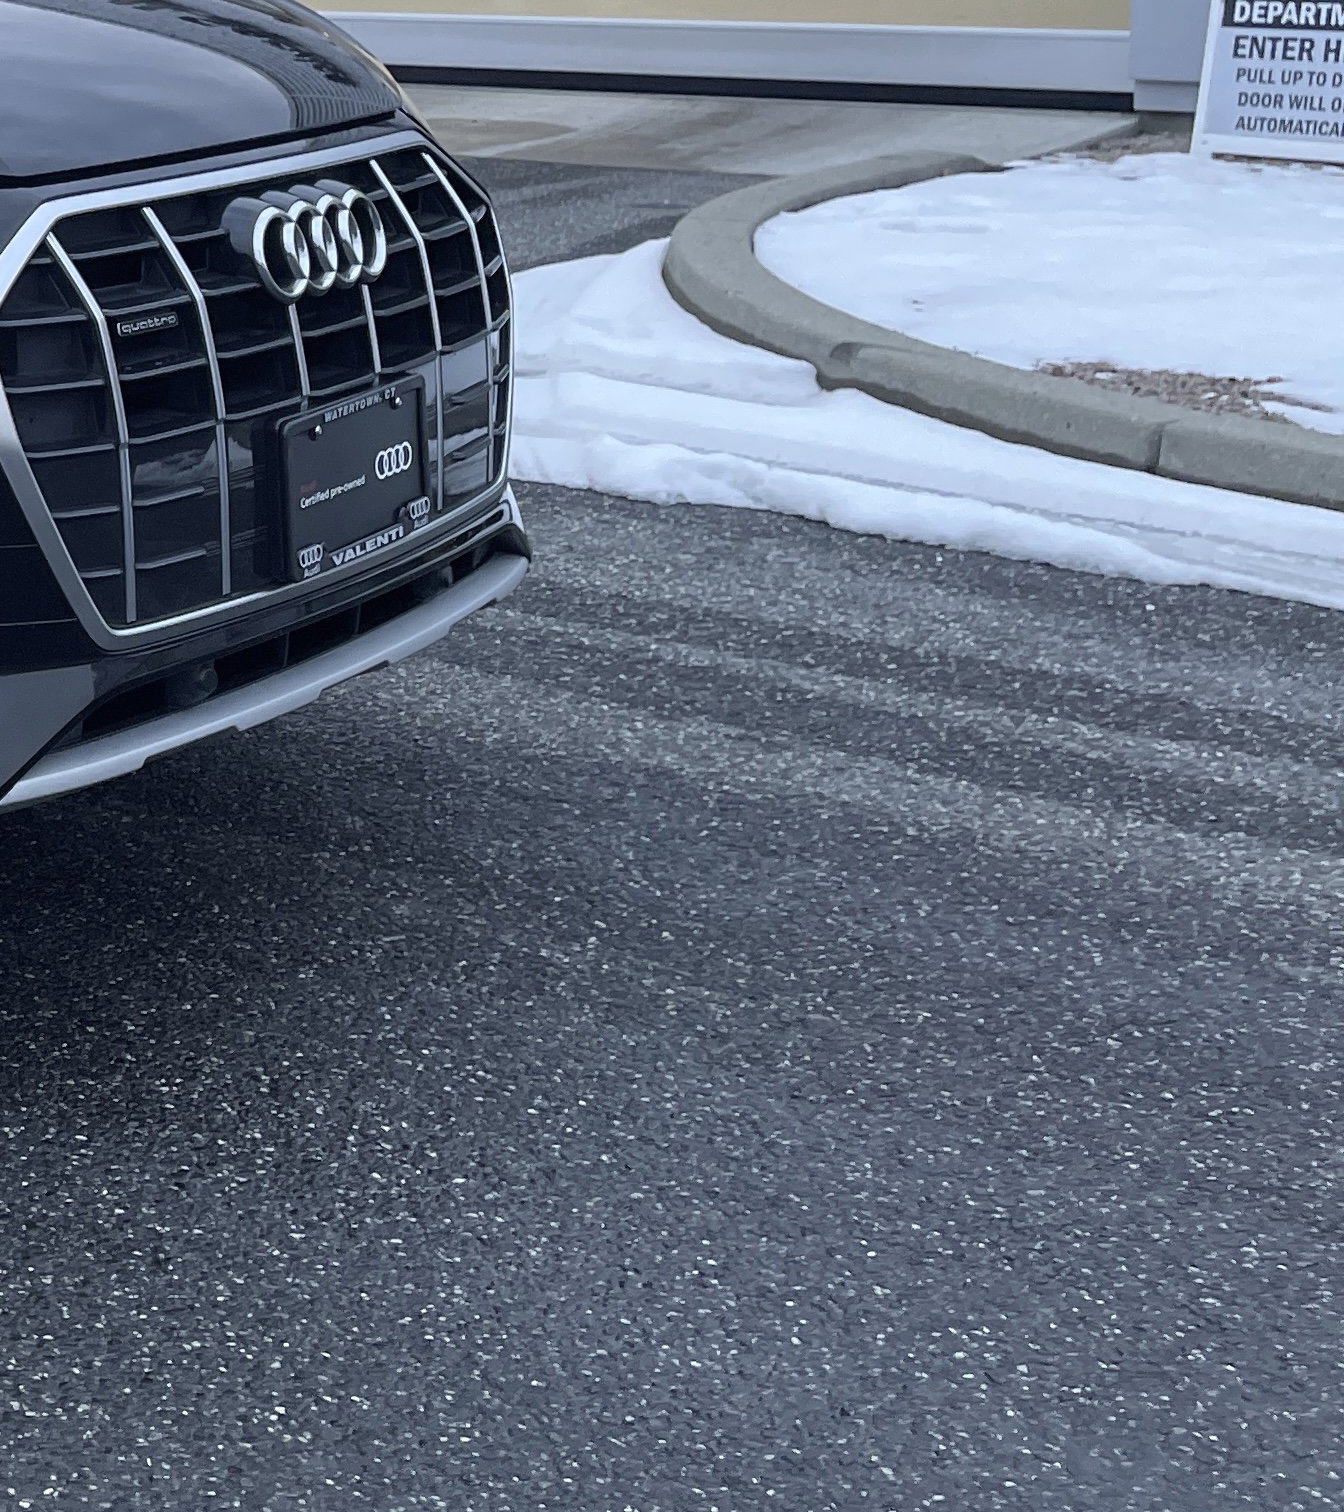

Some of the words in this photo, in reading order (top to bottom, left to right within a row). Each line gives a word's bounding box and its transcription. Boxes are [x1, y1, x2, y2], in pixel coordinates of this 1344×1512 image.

[1233, 35, 1315, 62] ENTER
[1323, 38, 1344, 63] H
[1236, 67, 1275, 85] PULL
[1281, 69, 1303, 86] UP
[1307, 70, 1327, 87] TO
[1237, 91, 1284, 110] DOOR
[1288, 93, 1326, 112] WILL
[121, 314, 177, 334] quattro
[331, 525, 404, 567] VALENTI
